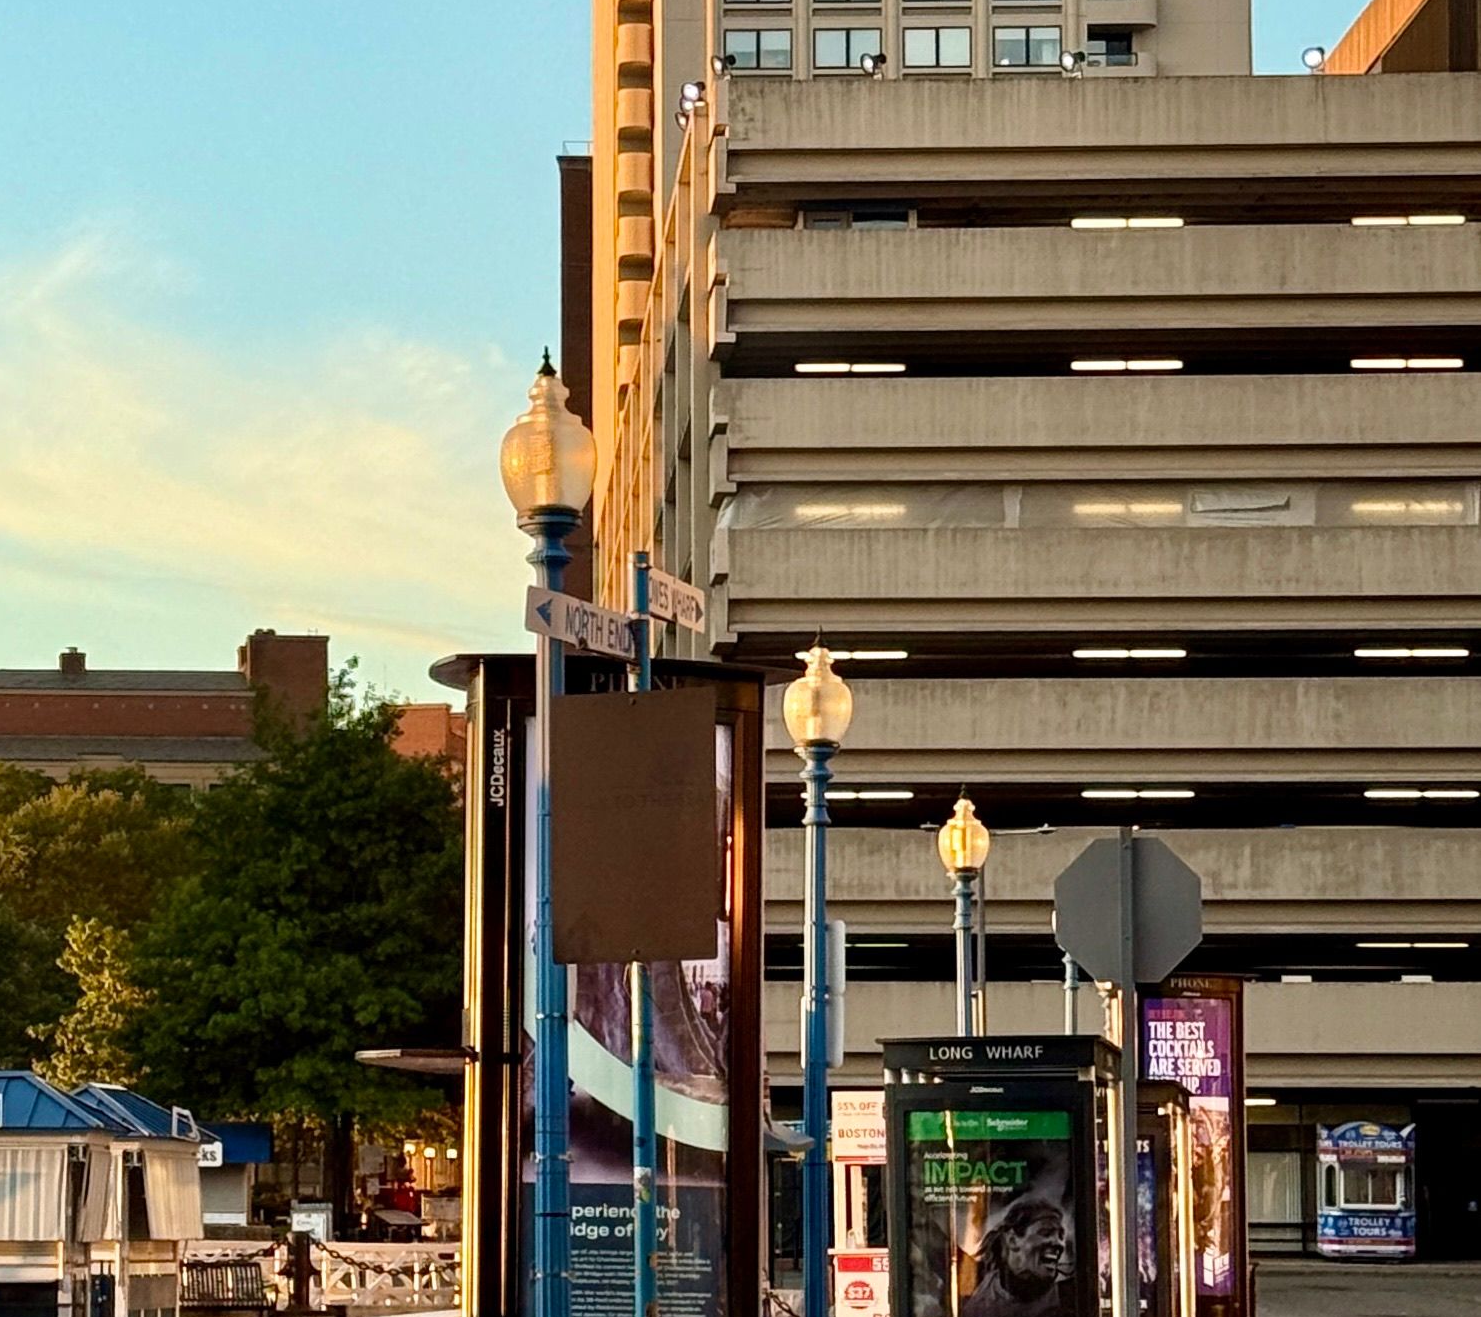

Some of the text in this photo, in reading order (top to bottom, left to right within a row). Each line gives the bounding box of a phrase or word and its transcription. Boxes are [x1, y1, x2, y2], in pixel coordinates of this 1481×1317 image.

[649, 576, 668, 611] WES
[565, 602, 633, 654] NORTH END
[590, 672, 680, 692] PHNE
[489, 728, 505, 807] JCDecaux
[1148, 1022, 1205, 1039] THE BEST
[929, 1045, 1043, 1060] LONG WHARF
[1149, 1040, 1214, 1058] COCKTAILS
[1149, 1058, 1222, 1076] ARE SERVED
[838, 1128, 885, 1138] BOSTON
[1338, 1140, 1372, 1148] TROLLEY
[1374, 1140, 1402, 1148] TOURS
[199, 1147, 217, 1161] ks
[925, 1161, 1027, 1184] IMPACT
[656, 1204, 680, 1219] the
[614, 1222, 635, 1236] of
[1348, 1217, 1391, 1226] TROLLEY
[1352, 1227, 1387, 1236] TOURS
